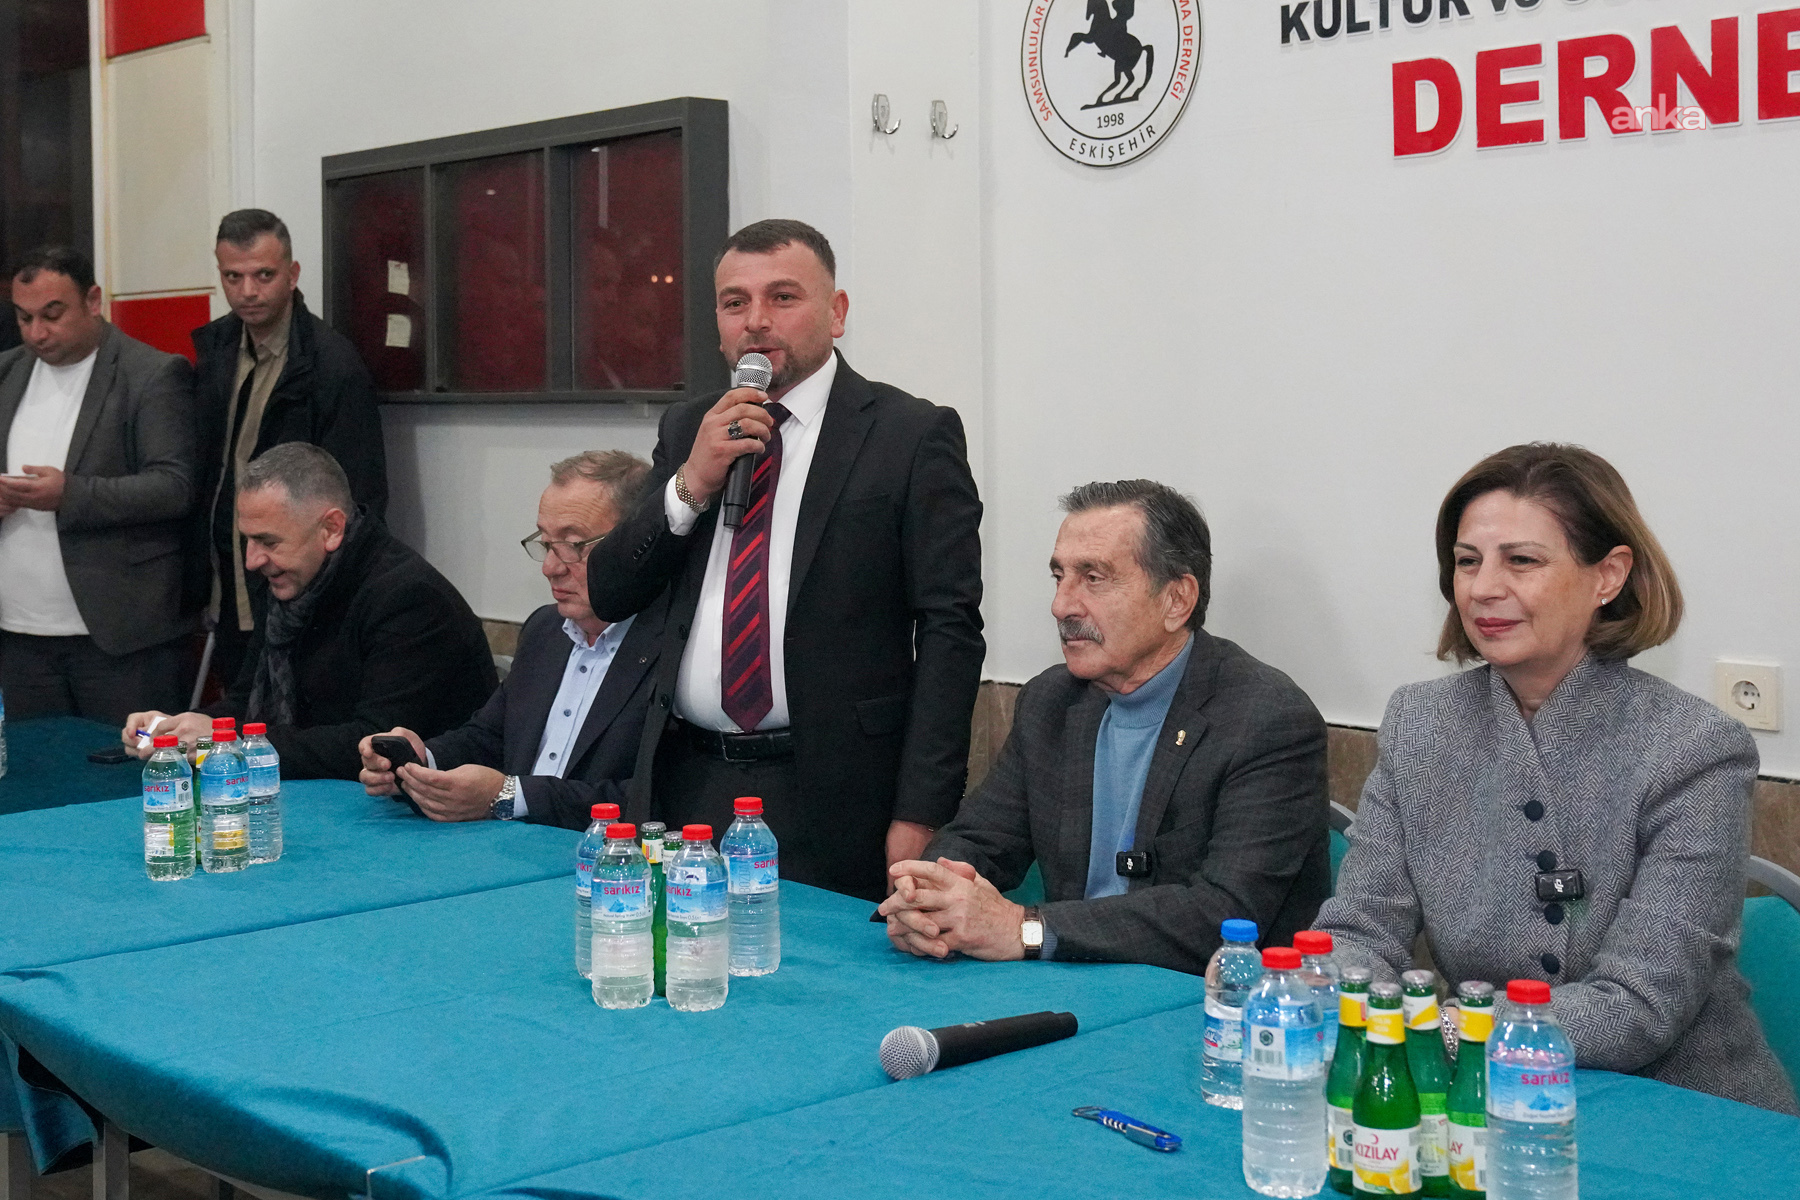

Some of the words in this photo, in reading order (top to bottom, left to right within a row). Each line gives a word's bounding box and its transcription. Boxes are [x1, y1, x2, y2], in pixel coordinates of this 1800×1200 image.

[1028, 5, 1053, 122] SAMSUNLULAR
[1170, 25, 1193, 101] DERNEĞİ
[1096, 112, 1125, 129] 1998
[1069, 124, 1157, 161] ESKİŞEHİR
